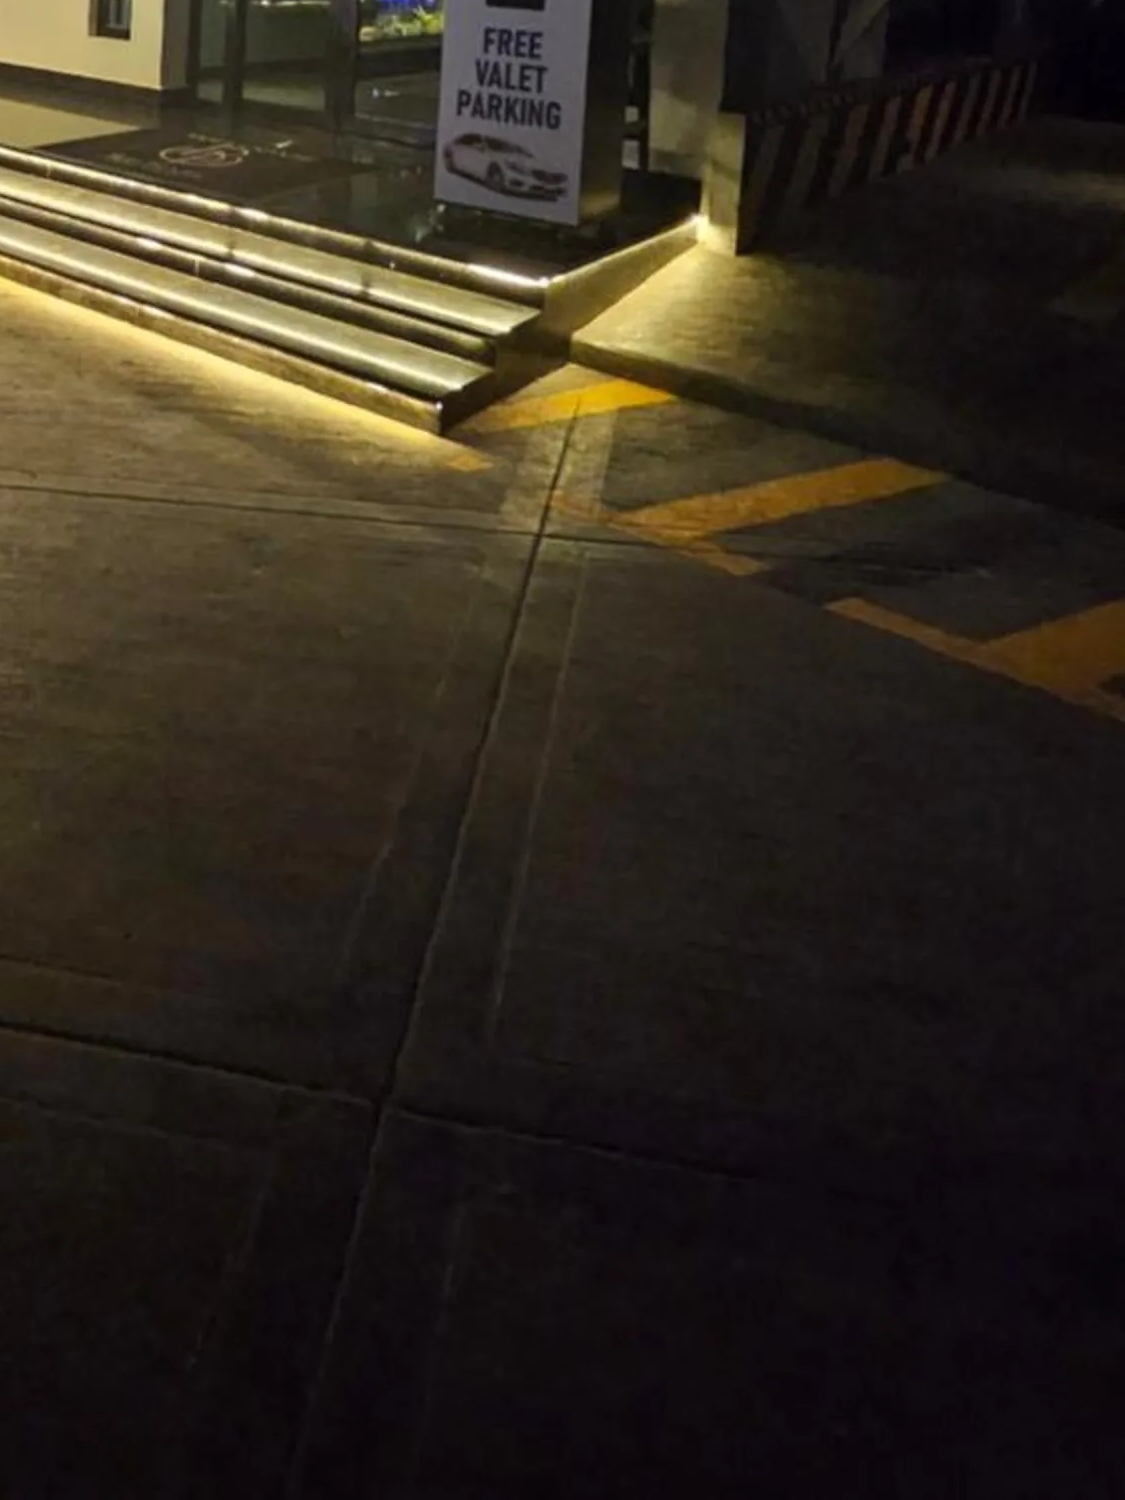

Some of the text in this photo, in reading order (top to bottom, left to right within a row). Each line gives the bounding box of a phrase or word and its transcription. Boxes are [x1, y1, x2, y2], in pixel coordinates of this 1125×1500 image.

[483, 27, 544, 59] FREE
[475, 59, 549, 94] VALET
[456, 88, 562, 130] PARKING
